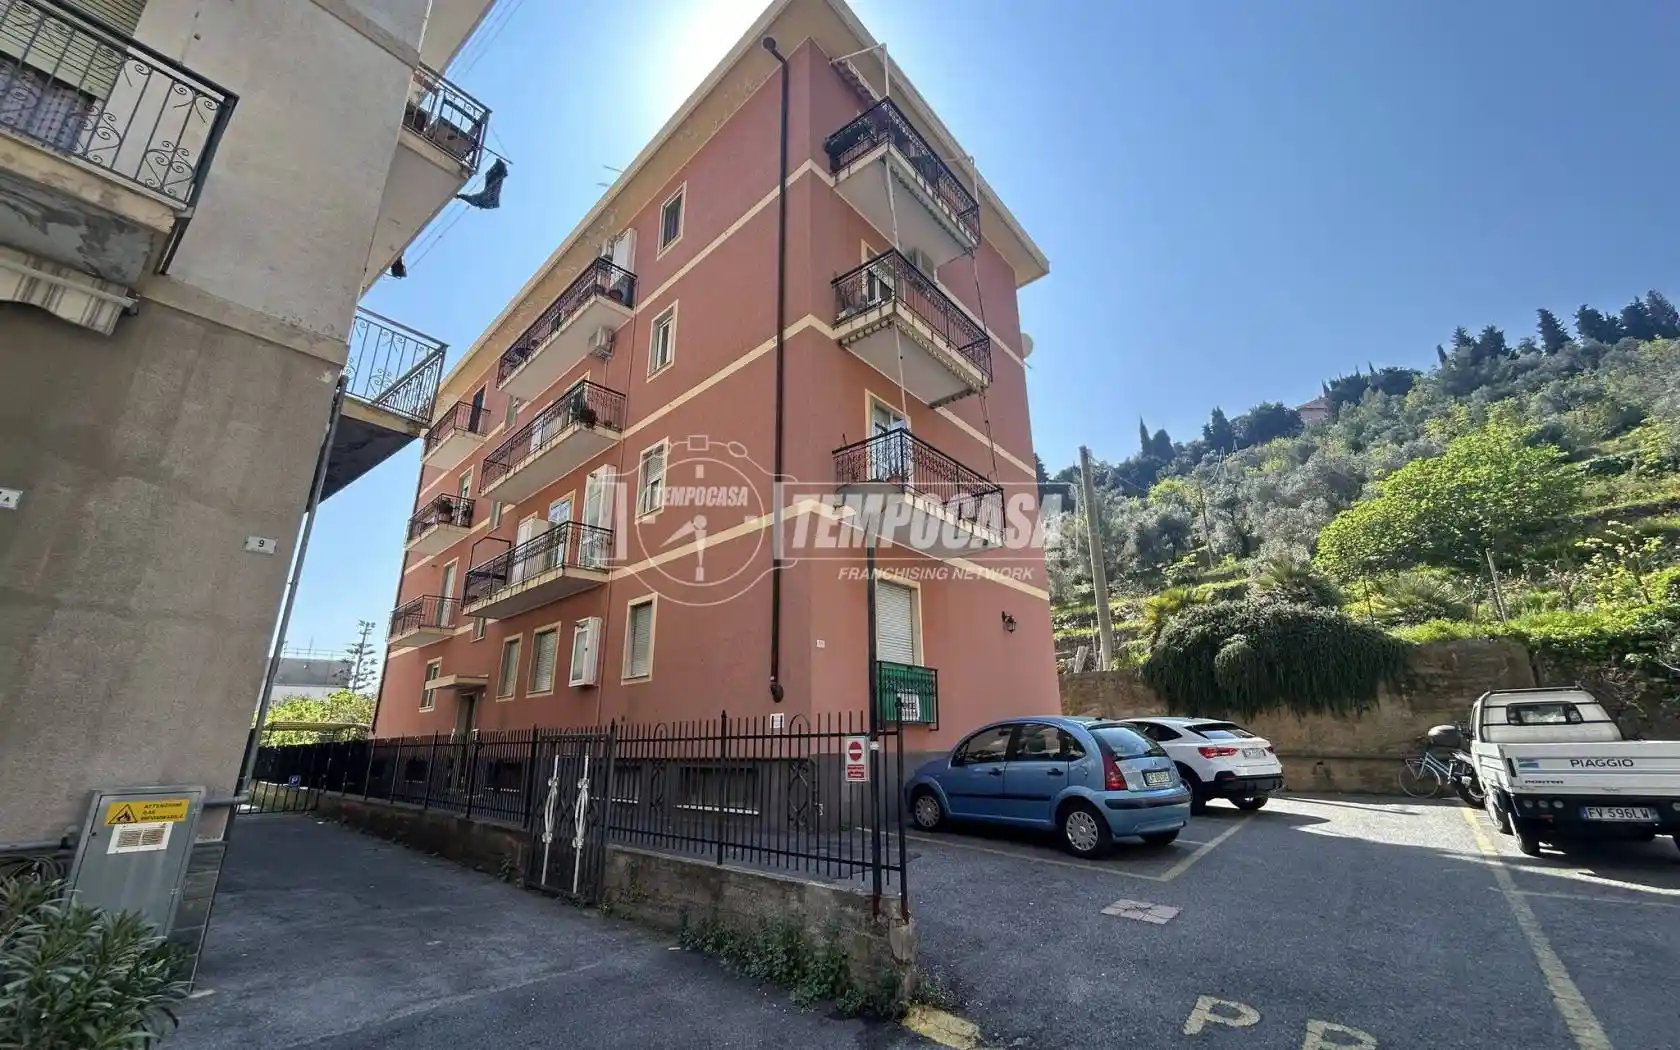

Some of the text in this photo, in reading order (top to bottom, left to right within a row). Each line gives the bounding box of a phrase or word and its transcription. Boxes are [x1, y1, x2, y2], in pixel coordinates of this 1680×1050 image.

[258, 539, 264, 547] 9
[1570, 758, 1634, 768] PIAGGIO
[1183, 994, 1261, 1035] P
